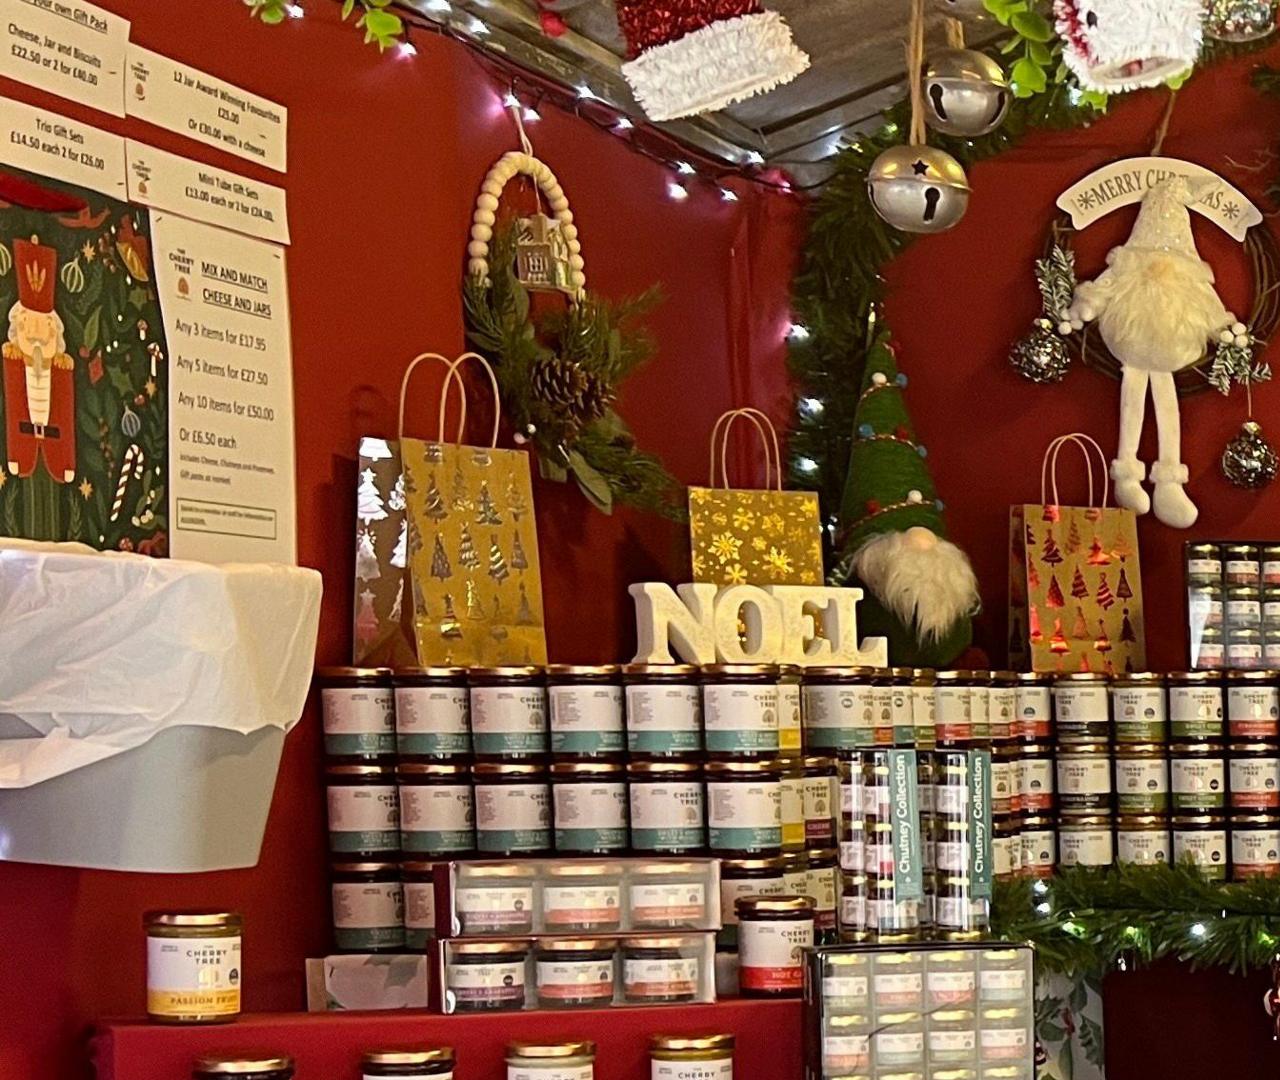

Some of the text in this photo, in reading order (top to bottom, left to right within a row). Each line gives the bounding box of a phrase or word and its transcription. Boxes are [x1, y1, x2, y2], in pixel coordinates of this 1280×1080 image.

[1091, 170, 1142, 205] MERRY
[201, 262, 268, 289] MIX AND MATCH
[203, 288, 271, 316] CHEESE AND JARS
[176, 318, 191, 335] Any
[194, 323, 198, 336] 3
[201, 323, 223, 342] items
[226, 330, 237, 344] for
[179, 428, 237, 449] Or £6.50 each
[628, 582, 888, 668] NOEL
[896, 754, 913, 874] Chutney Collection
[973, 757, 985, 873] Chutney Collection
